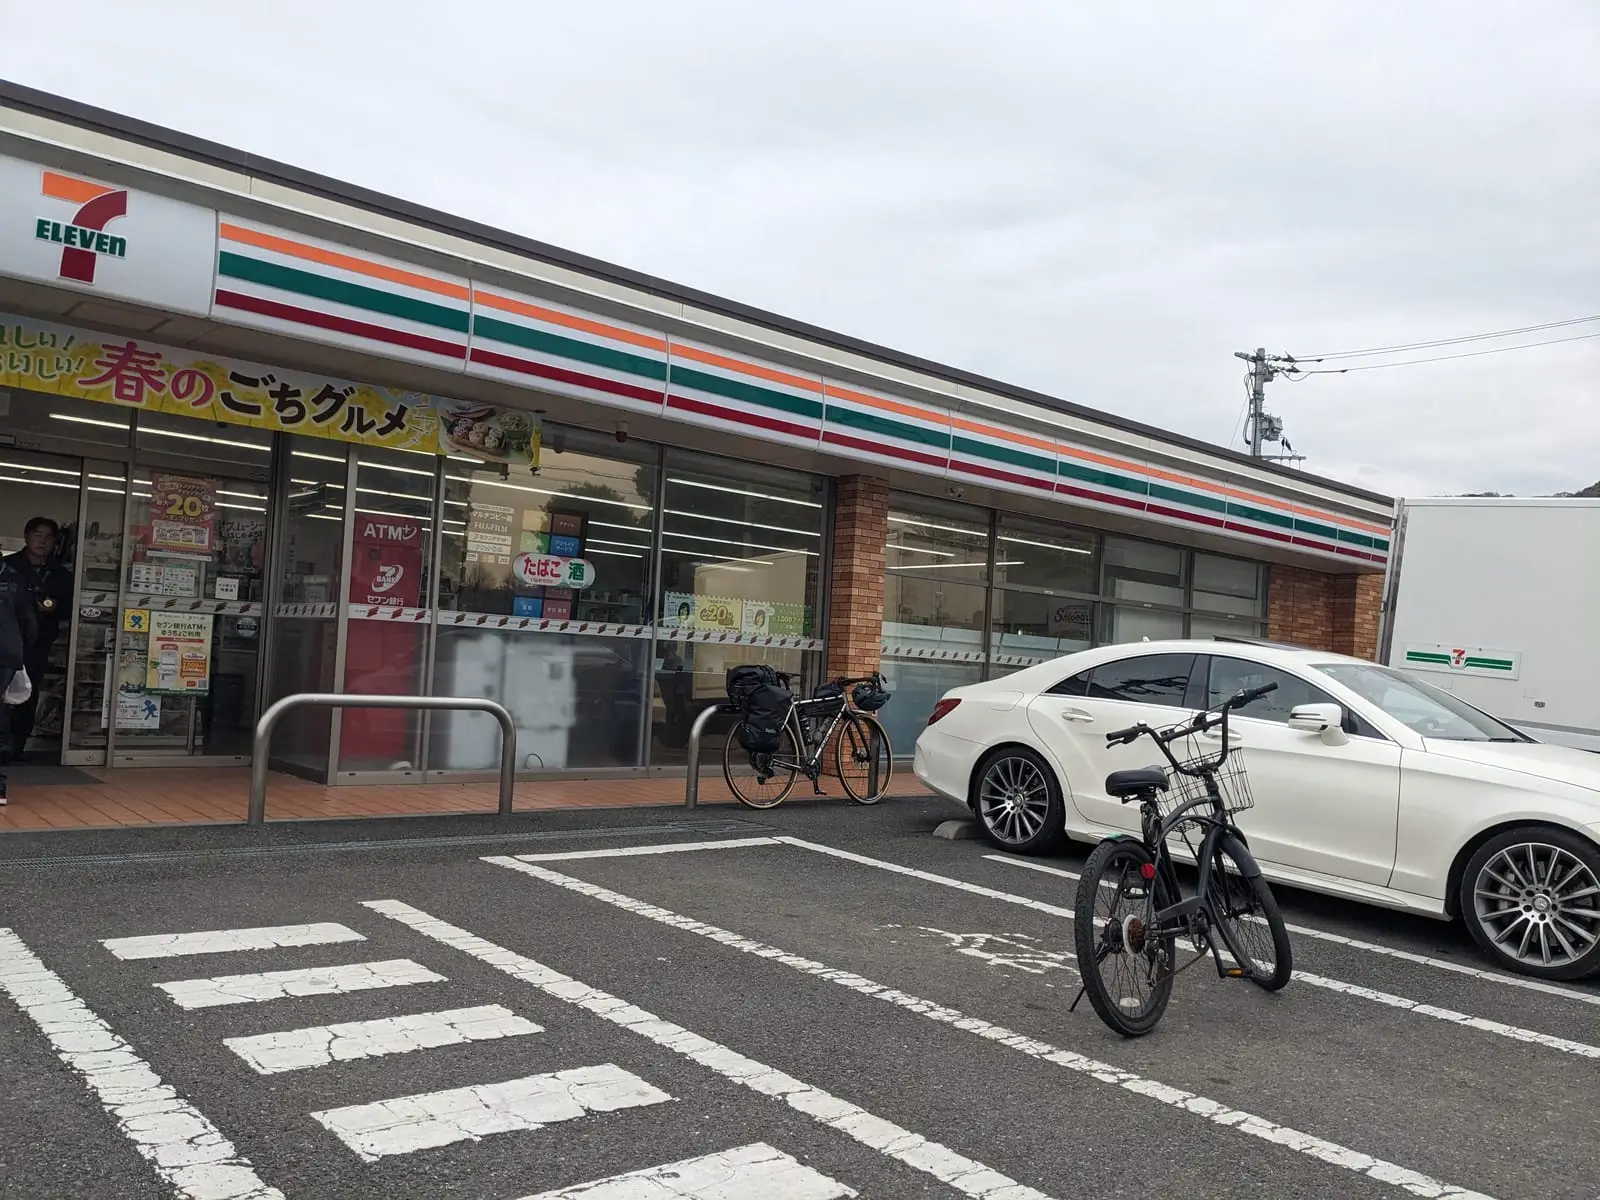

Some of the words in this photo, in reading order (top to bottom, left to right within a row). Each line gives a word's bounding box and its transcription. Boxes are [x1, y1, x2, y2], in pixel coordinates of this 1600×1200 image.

[0, 353, 84, 380] いしい!
[78, 340, 409, 437] 春のごちグルメ
[523, 556, 562, 578] たばこ
[568, 561, 585, 581] 酒
[366, 595, 405, 606] セブン銀行
